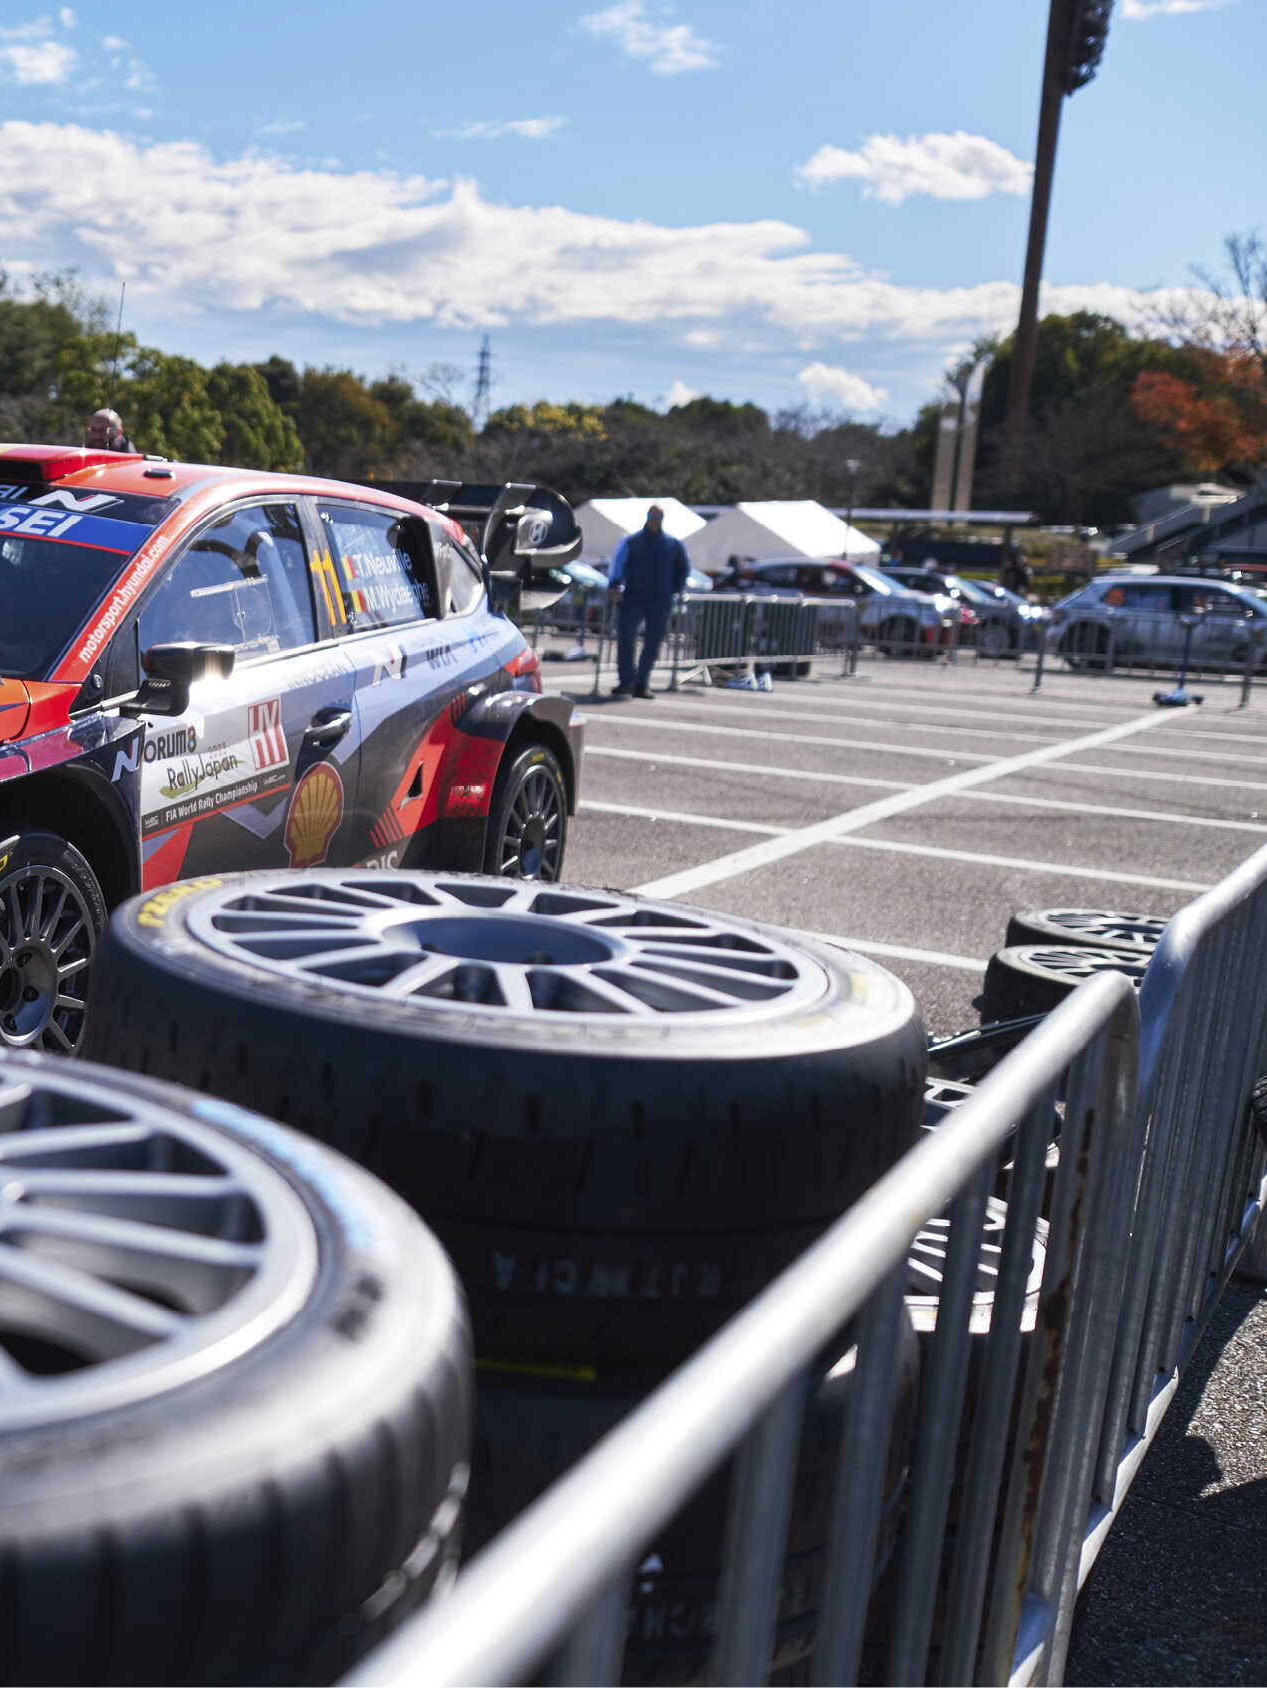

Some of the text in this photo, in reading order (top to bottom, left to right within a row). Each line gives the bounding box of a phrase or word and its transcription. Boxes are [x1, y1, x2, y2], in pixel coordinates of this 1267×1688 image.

[78, 535, 169, 663] motorsport.hyundai.com
[309, 549, 347, 627] 11
[165, 808, 178, 822] FIA
[178, 800, 198, 818] World
[198, 796, 215, 812] Rally
[215, 781, 259, 805] Championship
